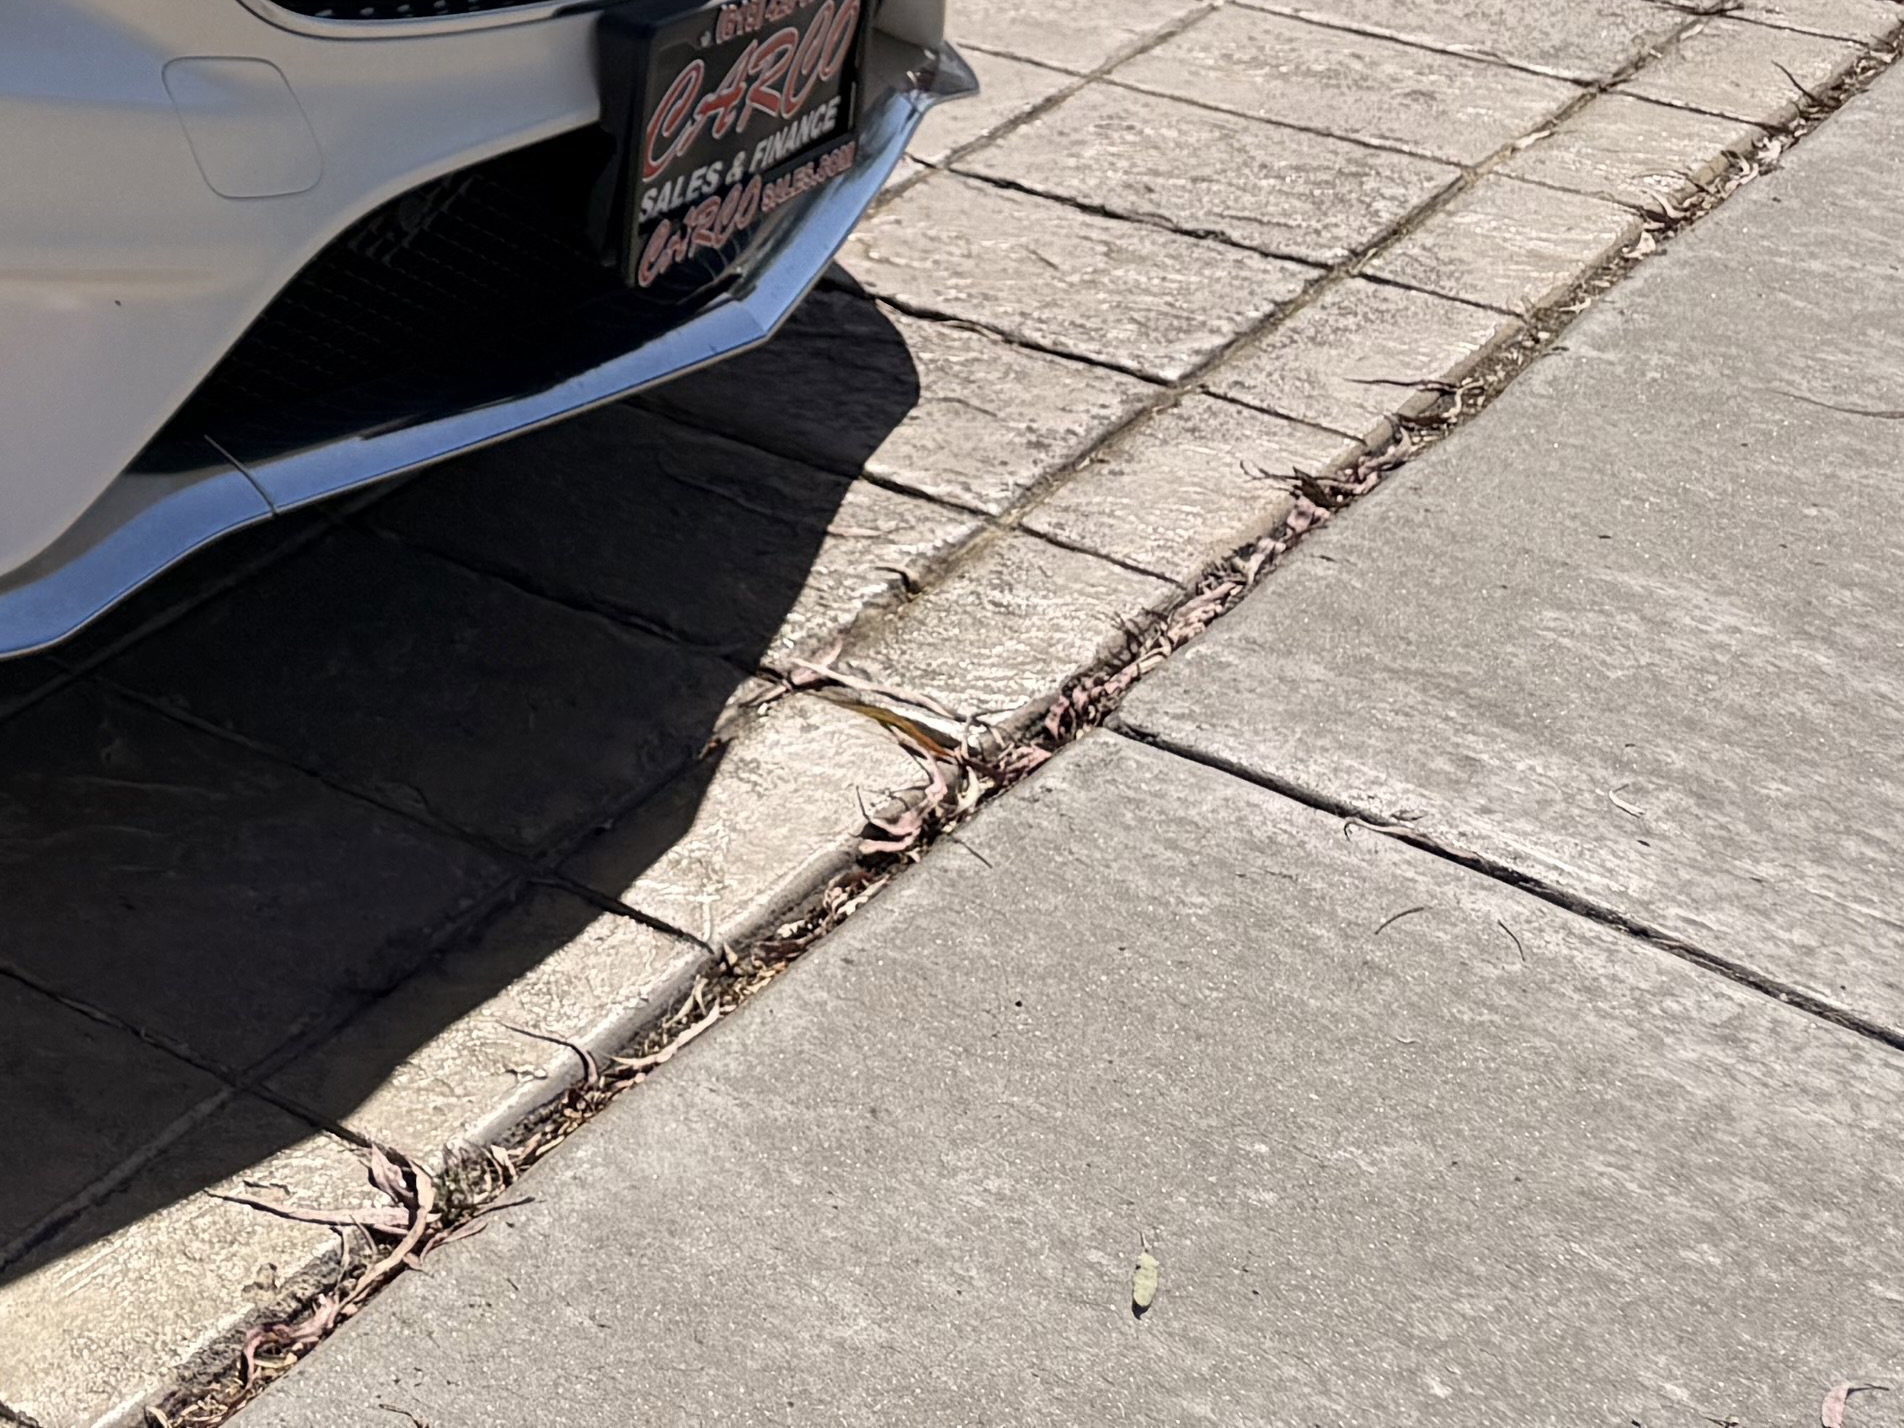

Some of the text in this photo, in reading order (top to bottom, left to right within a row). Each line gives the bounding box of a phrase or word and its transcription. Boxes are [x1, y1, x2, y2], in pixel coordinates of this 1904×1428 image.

[638, 96, 842, 223] SALES & FINANCE
